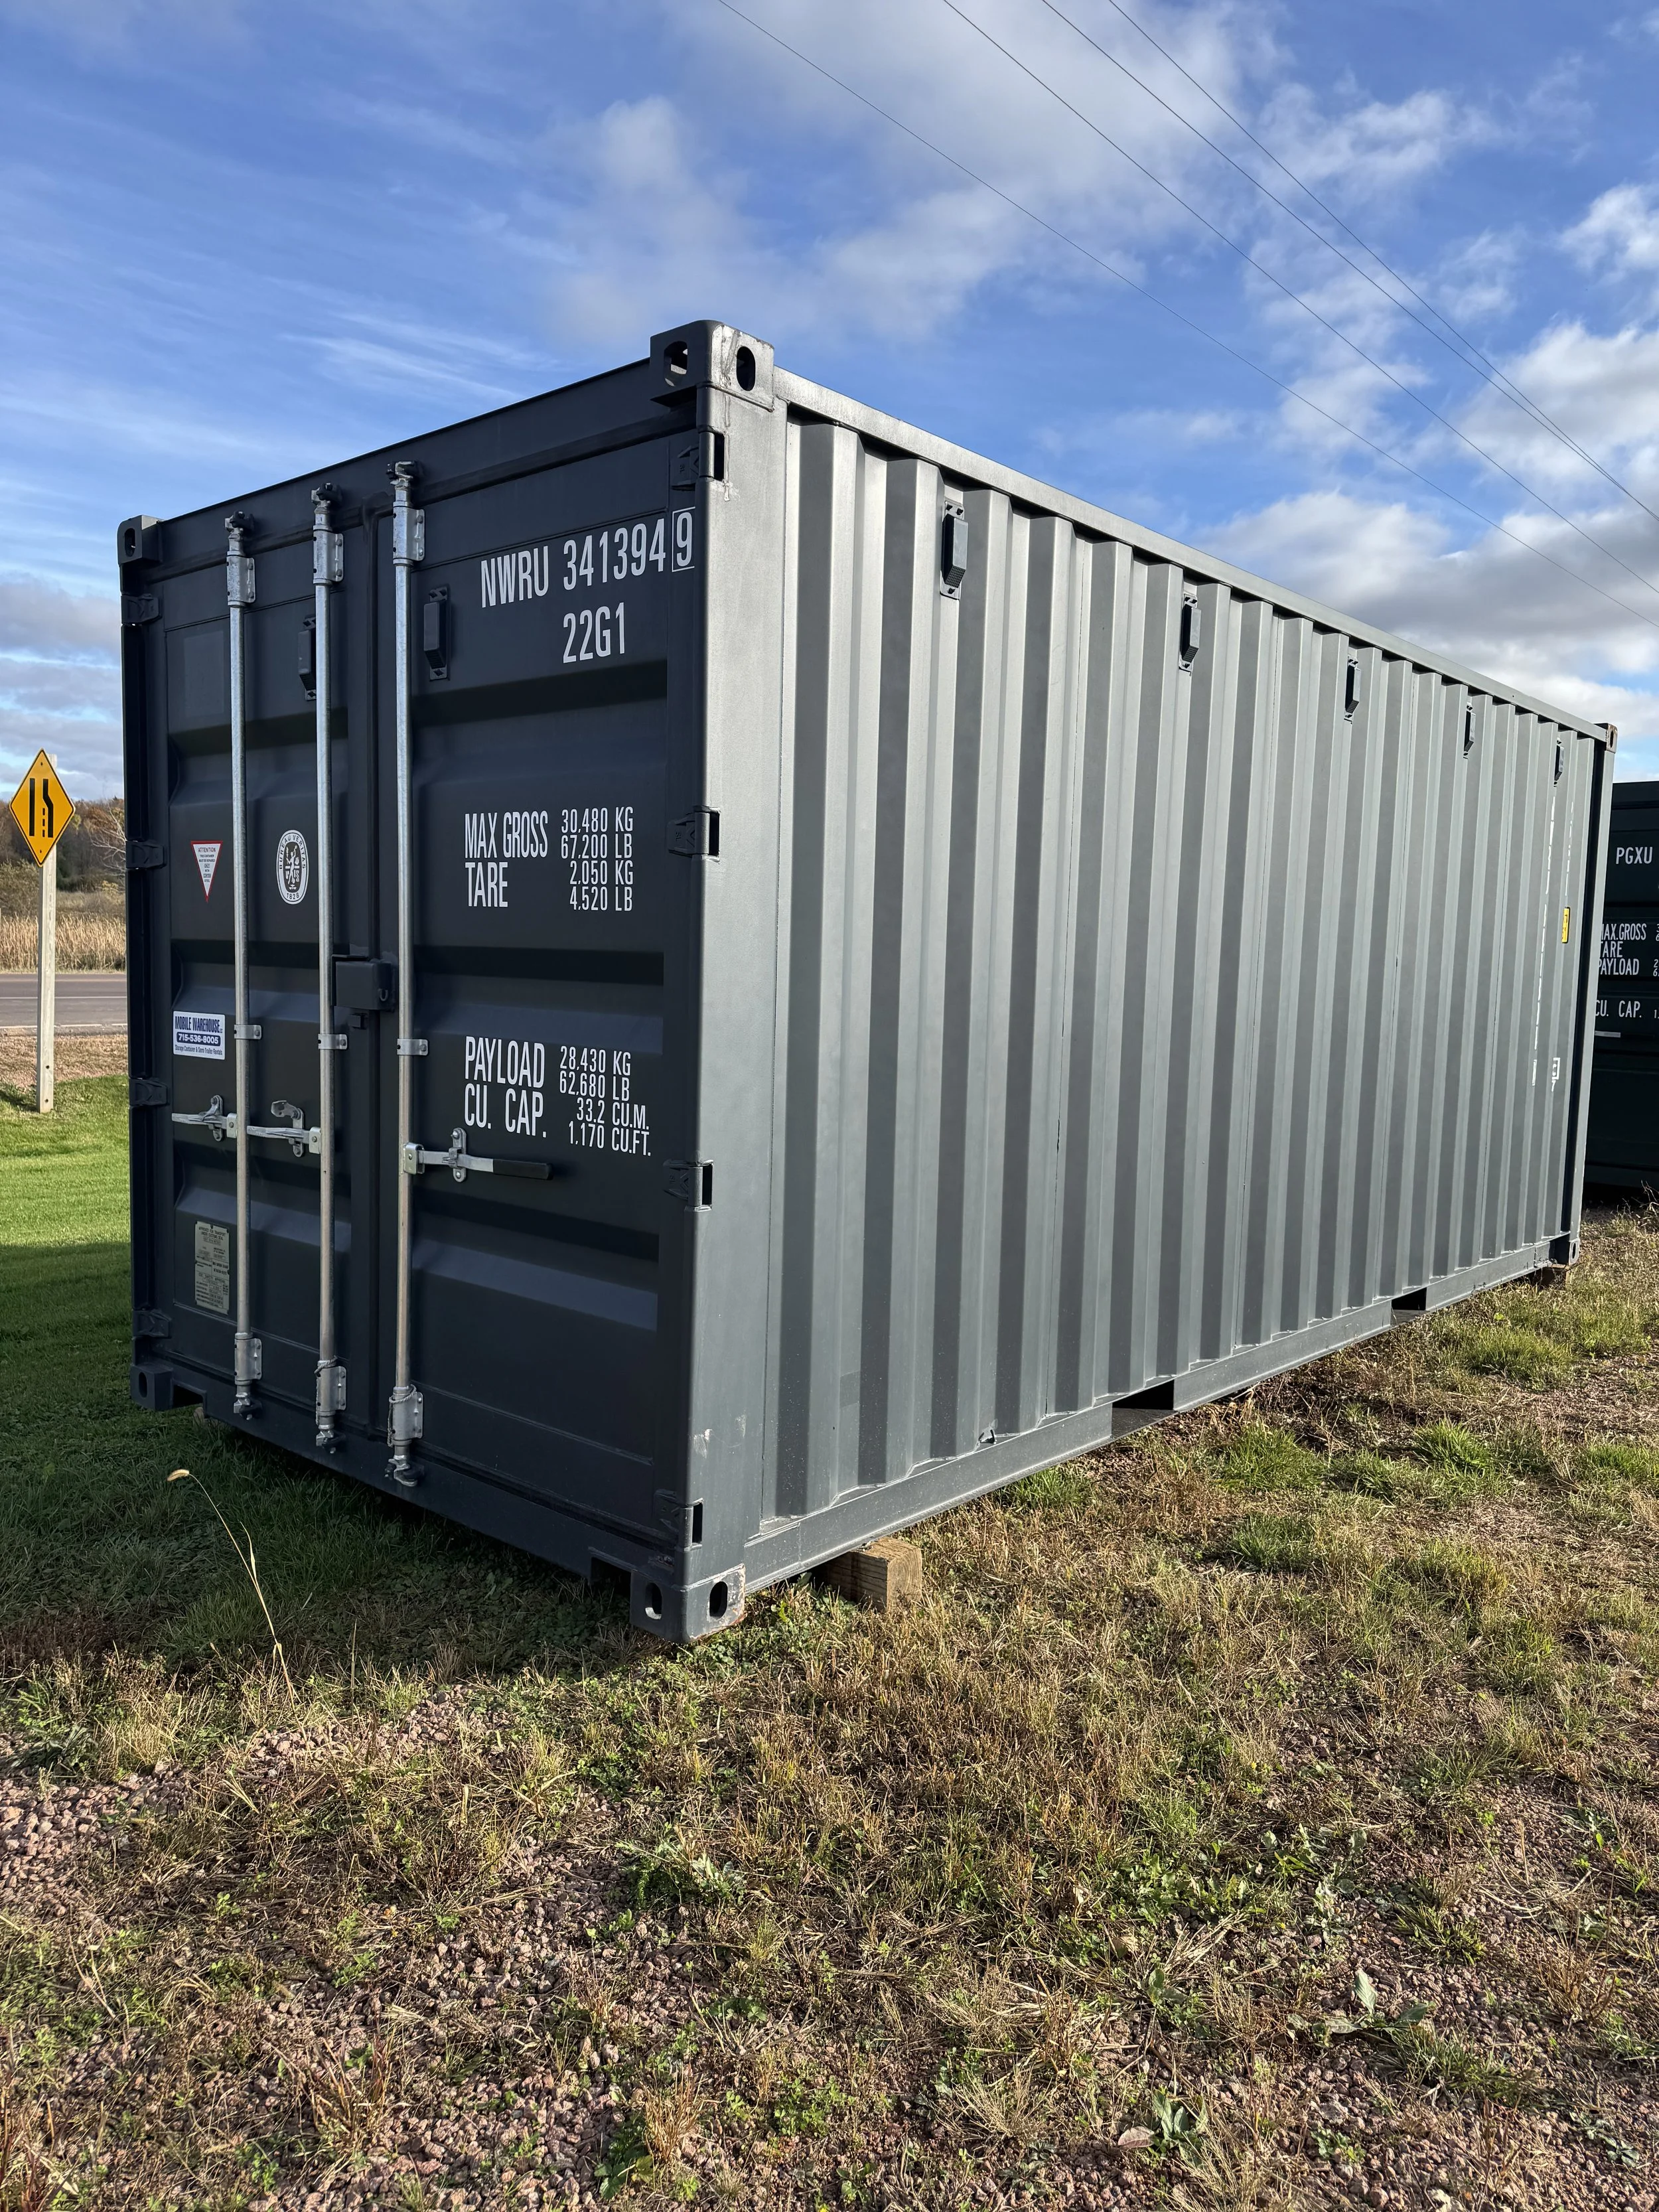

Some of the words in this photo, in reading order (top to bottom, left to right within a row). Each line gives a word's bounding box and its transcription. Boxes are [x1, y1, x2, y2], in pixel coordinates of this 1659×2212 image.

[480, 546, 549, 608] NWRU
[563, 518, 666, 591] 341394
[676, 512, 693, 567] 9
[563, 602, 625, 664] 22G1
[465, 812, 498, 858] MAX
[503, 810, 548, 858] GROSS
[561, 807, 608, 834] 30,480
[615, 806, 634, 832] KG
[561, 834, 608, 859] 67,200
[615, 833, 632, 859] LB
[1616, 846, 1653, 865] PGXU
[465, 861, 508, 907] TARE
[569, 860, 608, 885] 2,050
[615, 860, 633, 885] KG
[569, 886, 608, 911] 4,520
[615, 886, 632, 911] LB
[1601, 941, 1623, 958] ARE
[175, 1016, 191, 1030] MOBILE
[192, 1017, 220, 1033] WAREHOUSE
[1619, 1000, 1642, 1018] CAP.
[178, 1033, 218, 1044] 715-536-8005
[465, 1036, 545, 1088] PAYLOAD
[559, 1045, 606, 1074] 28,430
[613, 1051, 631, 1076] KG
[559, 1070, 605, 1098] 62,680
[613, 1076, 630, 1101] LB
[465, 1083, 492, 1129] CU.
[505, 1088, 547, 1138] CAP.
[577, 1097, 605, 1124] 33.2
[612, 1102, 650, 1130] CU.M.
[569, 1121, 605, 1149] 1,170
[611, 1128, 651, 1156] CU.FT.
